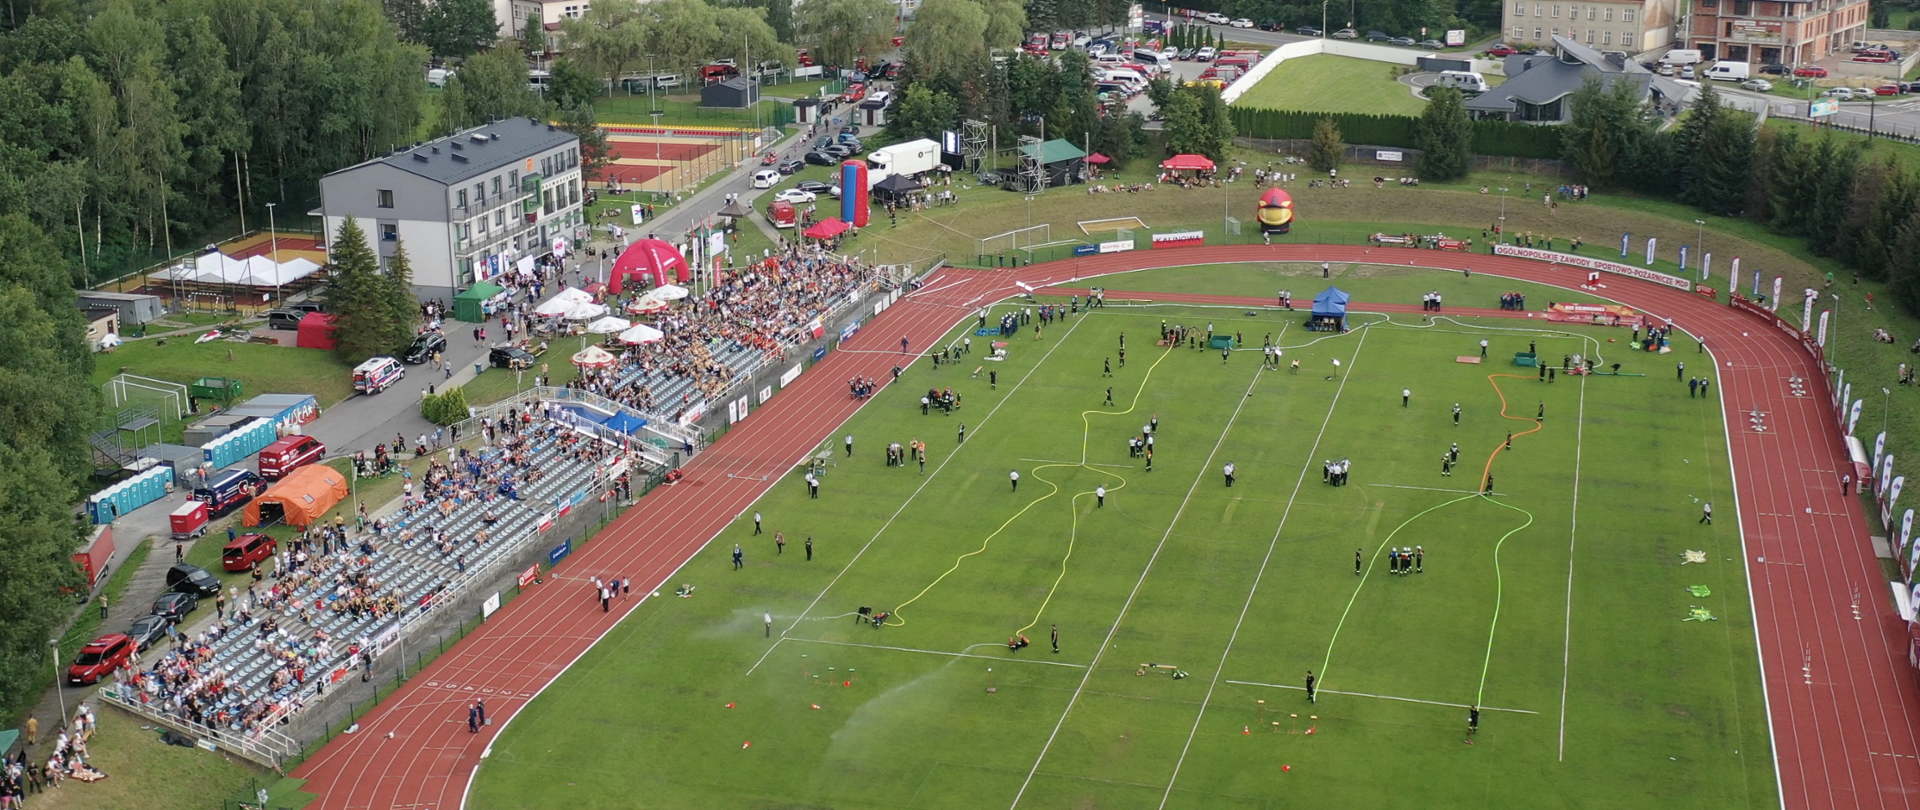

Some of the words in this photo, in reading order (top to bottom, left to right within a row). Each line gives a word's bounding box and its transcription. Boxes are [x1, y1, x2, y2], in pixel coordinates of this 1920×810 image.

[1156, 235, 1201, 245] KALINOWA
[1497, 247, 1558, 261] OGÓLNOPOLSKIE
[1560, 255, 1590, 266] ZAWODY
[1594, 261, 1674, 285] SPORTOWO-POŻARNICZE
[1675, 279, 1689, 288] MDP
